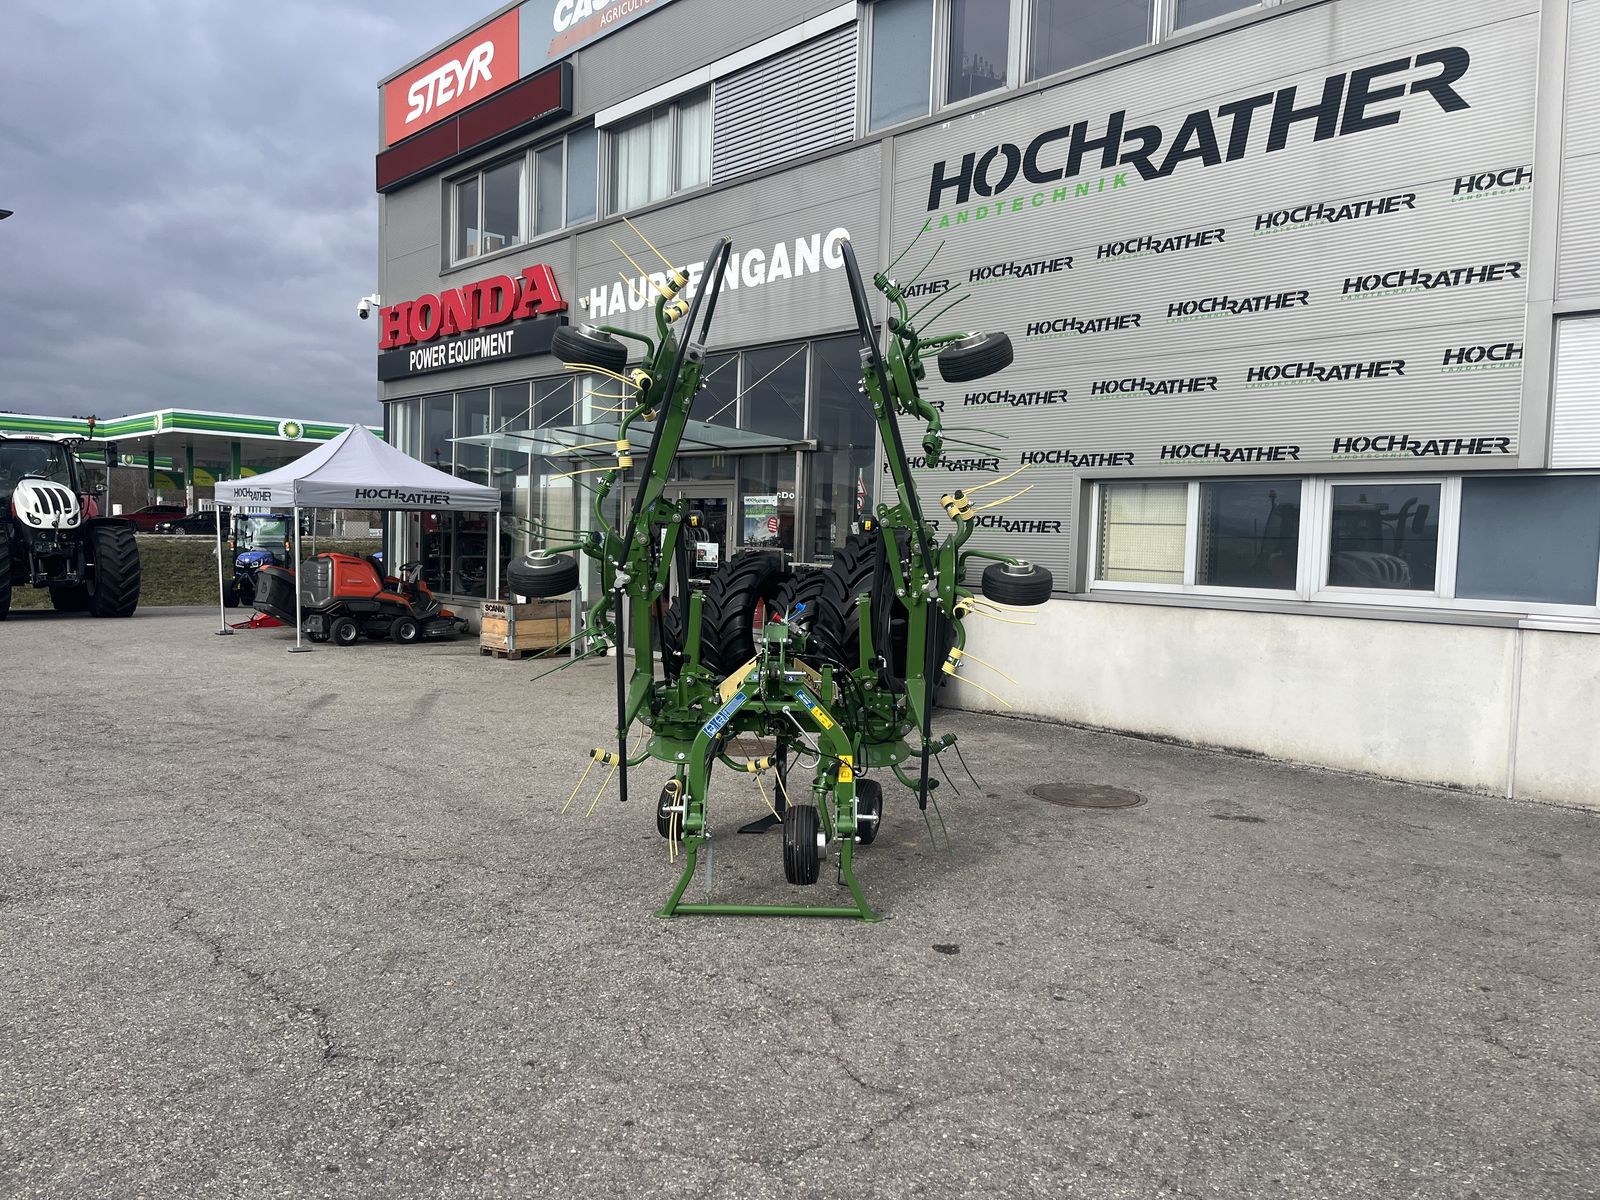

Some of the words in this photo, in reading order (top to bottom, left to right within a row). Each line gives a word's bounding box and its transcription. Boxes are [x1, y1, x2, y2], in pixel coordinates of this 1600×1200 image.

[405, 40, 495, 124] STEYR
[927, 46, 1471, 212] HOCHRATHER
[923, 172, 1128, 232] LANDTECHNIK
[1255, 193, 1416, 231] HOCHRATHER
[1097, 228, 1226, 259] HOCHRATHER
[969, 256, 1073, 282] HOCHRATHER
[1342, 261, 1522, 294] HOCHRATHER
[379, 264, 568, 349] HONDA
[1167, 290, 1310, 318] HOCHRATHER
[1026, 313, 1142, 336] HOCHRATHER
[409, 345, 446, 371] POWER
[448, 330, 514, 364] EQUIPMENT
[1246, 359, 1406, 383] HOCHRATHER
[1091, 376, 1218, 396] HOCHRATHER
[963, 389, 1068, 407] HOCHRATHER
[1160, 443, 1300, 462] HOCHRATHER
[1334, 434, 1511, 457] HOCHRATHER
[907, 456, 1000, 472] HOHRATHER
[1020, 450, 1135, 468] HOCHRATHER
[234, 487, 272, 501] HOCHRATHER
[355, 488, 450, 505] HOCHRATHER
[973, 515, 1062, 534] OCHRATHER
[485, 604, 505, 613] SCANIA
